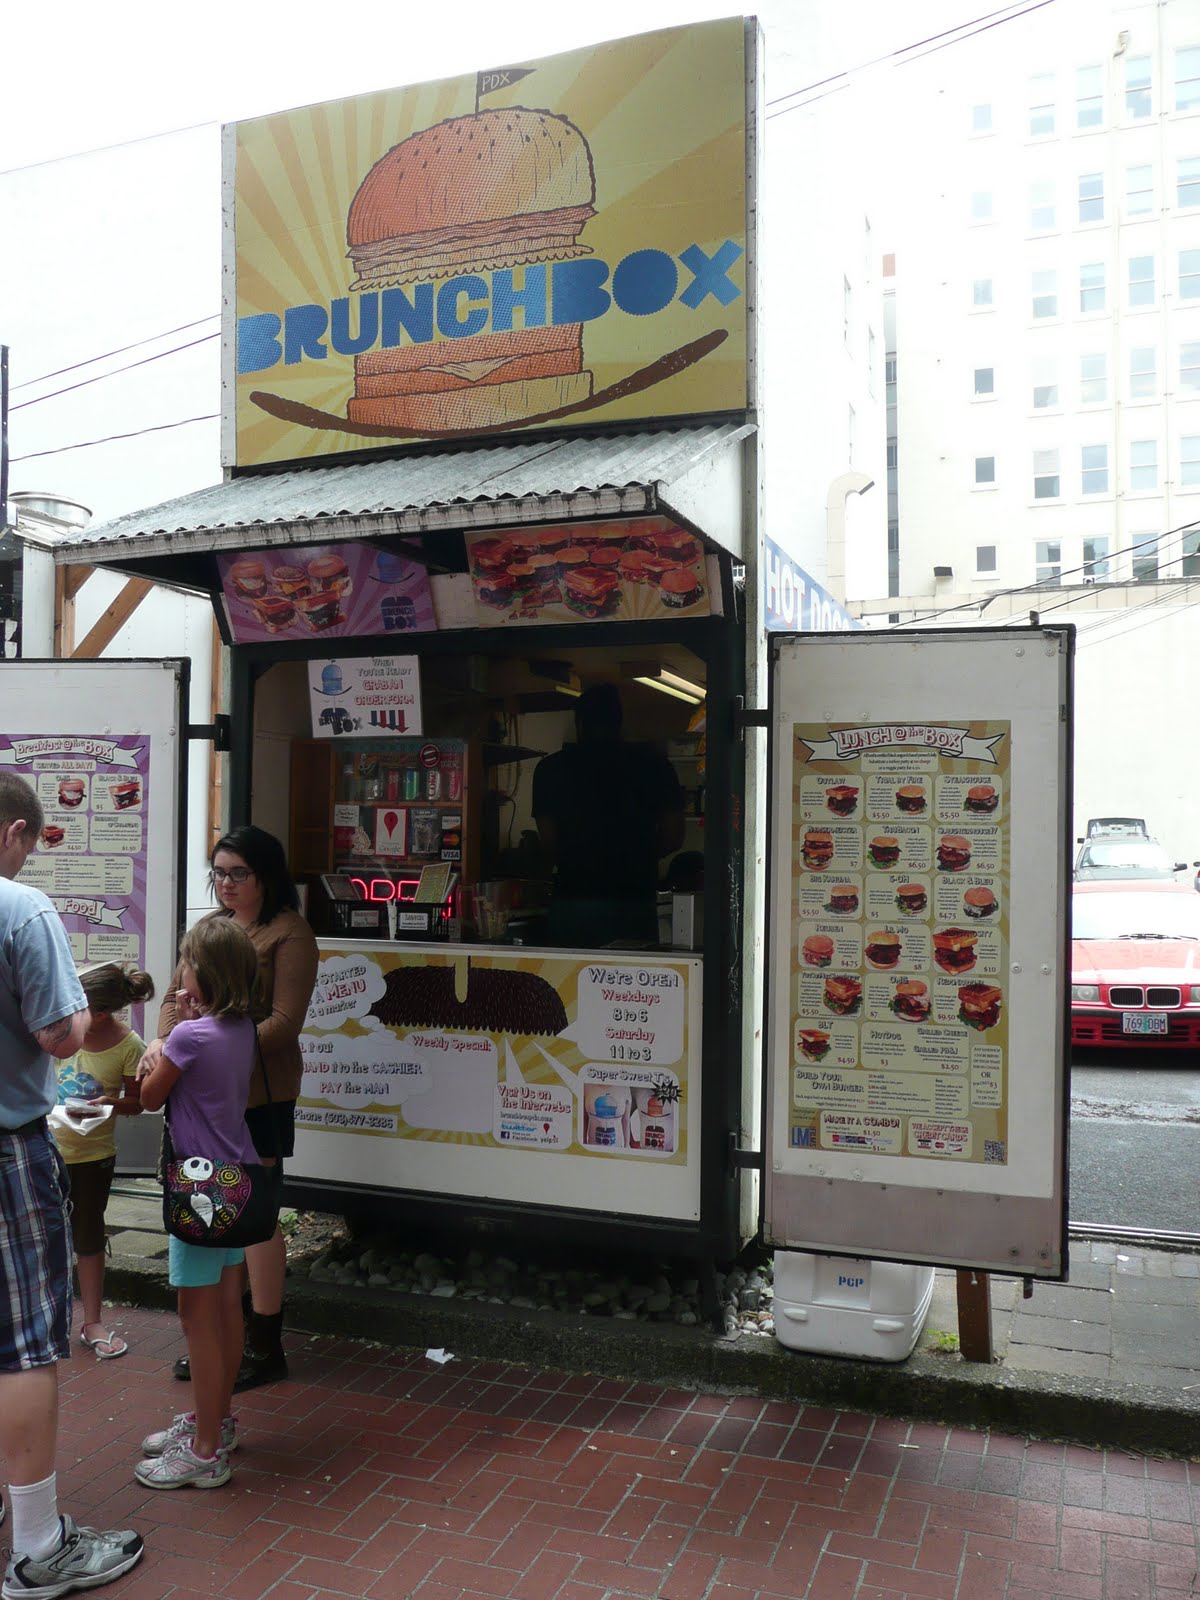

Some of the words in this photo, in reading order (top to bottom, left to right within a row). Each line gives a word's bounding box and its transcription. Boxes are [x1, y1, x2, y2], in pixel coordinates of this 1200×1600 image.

[481, 72, 512, 92] PDX
[238, 239, 744, 374] BRUNCHBOX
[766, 546, 806, 630] HOT
[811, 588, 850, 631] DO
[387, 667, 412, 676] READY
[836, 729, 892, 750] LUNCH
[894, 728, 908, 741] @
[908, 727, 925, 739] the
[17, 740, 62, 755] Breakfast
[816, 776, 846, 785] OUTLAW
[804, 811, 812, 819] $5
[872, 811, 890, 819] $5.50
[940, 811, 960, 820] $5.50
[850, 860, 858, 868] $7
[908, 861, 926, 870] $6.50
[976, 862, 994, 870] $6.50
[64, 898, 98, 916] Food
[802, 908, 819, 916] $5.50
[939, 912, 957, 920] $4.75
[816, 925, 844, 933] REUBEN
[841, 960, 858, 968] $4.75
[320, 966, 366, 984] STARTED
[588, 968, 634, 985] We're
[636, 969, 679, 988] OPEN
[316, 990, 326, 1002] A
[326, 979, 366, 1000] MENU
[602, 988, 660, 1006] Weekdays
[308, 1008, 318, 1018] &
[318, 1008, 325, 1016] a
[326, 1000, 357, 1014] marker
[802, 1008, 819, 1016] $5.50
[612, 1008, 622, 1022] 8
[624, 1008, 637, 1022] to
[638, 1008, 648, 1023] 6
[818, 1021, 833, 1030] BLT
[1125, 1018, 1142, 1029] 769
[606, 1027, 655, 1044] Saturday
[317, 1042, 334, 1054] out
[412, 1036, 449, 1052] Weekly
[610, 1044, 625, 1060] 11
[628, 1046, 640, 1061] to
[642, 1046, 652, 1061] 3
[338, 1062, 351, 1074] to
[352, 1062, 369, 1074] the
[372, 1063, 423, 1074] CASHIER
[941, 1063, 959, 1071] $2.50
[587, 1068, 619, 1082] Super
[620, 1068, 653, 1082] Sweet
[796, 1071, 819, 1080] BUILD
[820, 1072, 842, 1082] YOUR
[320, 1083, 342, 1094] PAY
[344, 1082, 362, 1094] the
[364, 1084, 390, 1094] MAN
[498, 1085, 519, 1098] Visit
[520, 1086, 536, 1099] Us
[538, 1090, 552, 1101] on
[811, 1082, 828, 1091] OWN
[828, 1083, 864, 1093] BURGER
[502, 1098, 518, 1109] the
[521, 1098, 572, 1114] Interwebs
[294, 1110, 322, 1122] Phone
[501, 1124, 538, 1132] twitter
[863, 1129, 881, 1137] $1.50
